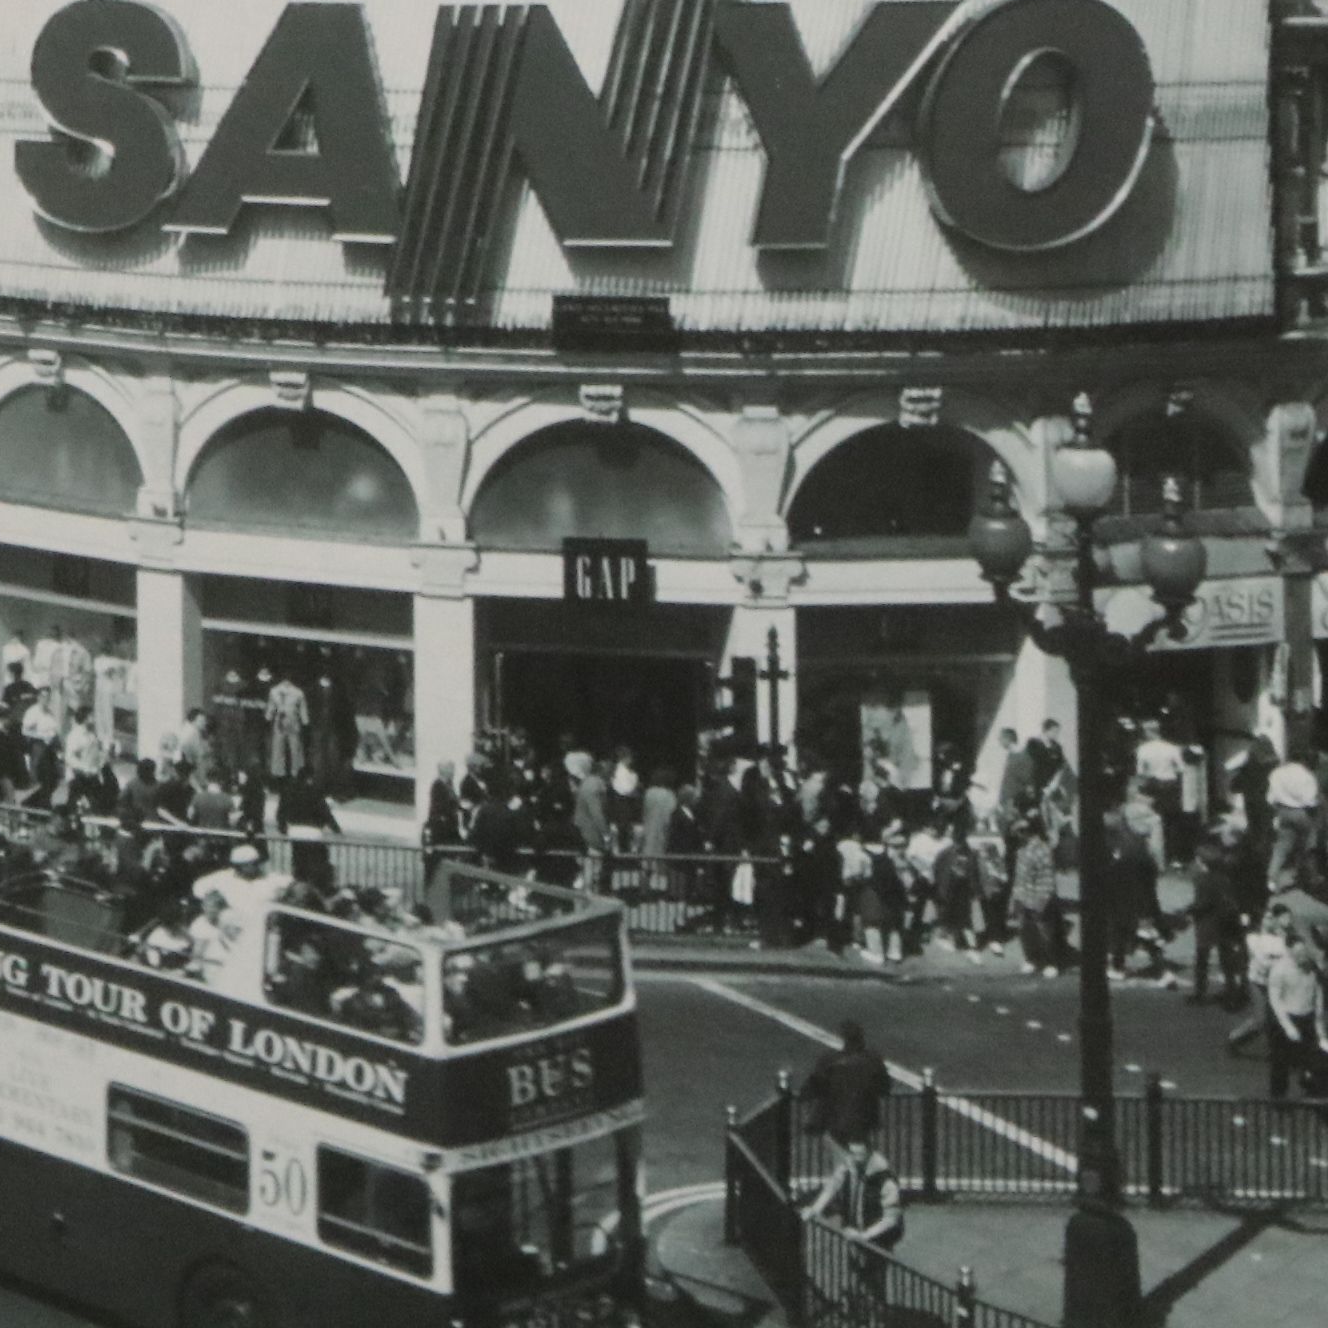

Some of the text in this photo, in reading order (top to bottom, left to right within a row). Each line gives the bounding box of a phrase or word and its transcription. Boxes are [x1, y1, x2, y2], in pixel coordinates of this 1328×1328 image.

[576, 556, 635, 600] GAP
[40, 963, 148, 1023] TOUR
[160, 1000, 216, 1041] OF
[227, 1018, 409, 1104] LONDON
[507, 1048, 593, 1107] BUS
[258, 1149, 308, 1217] 50
